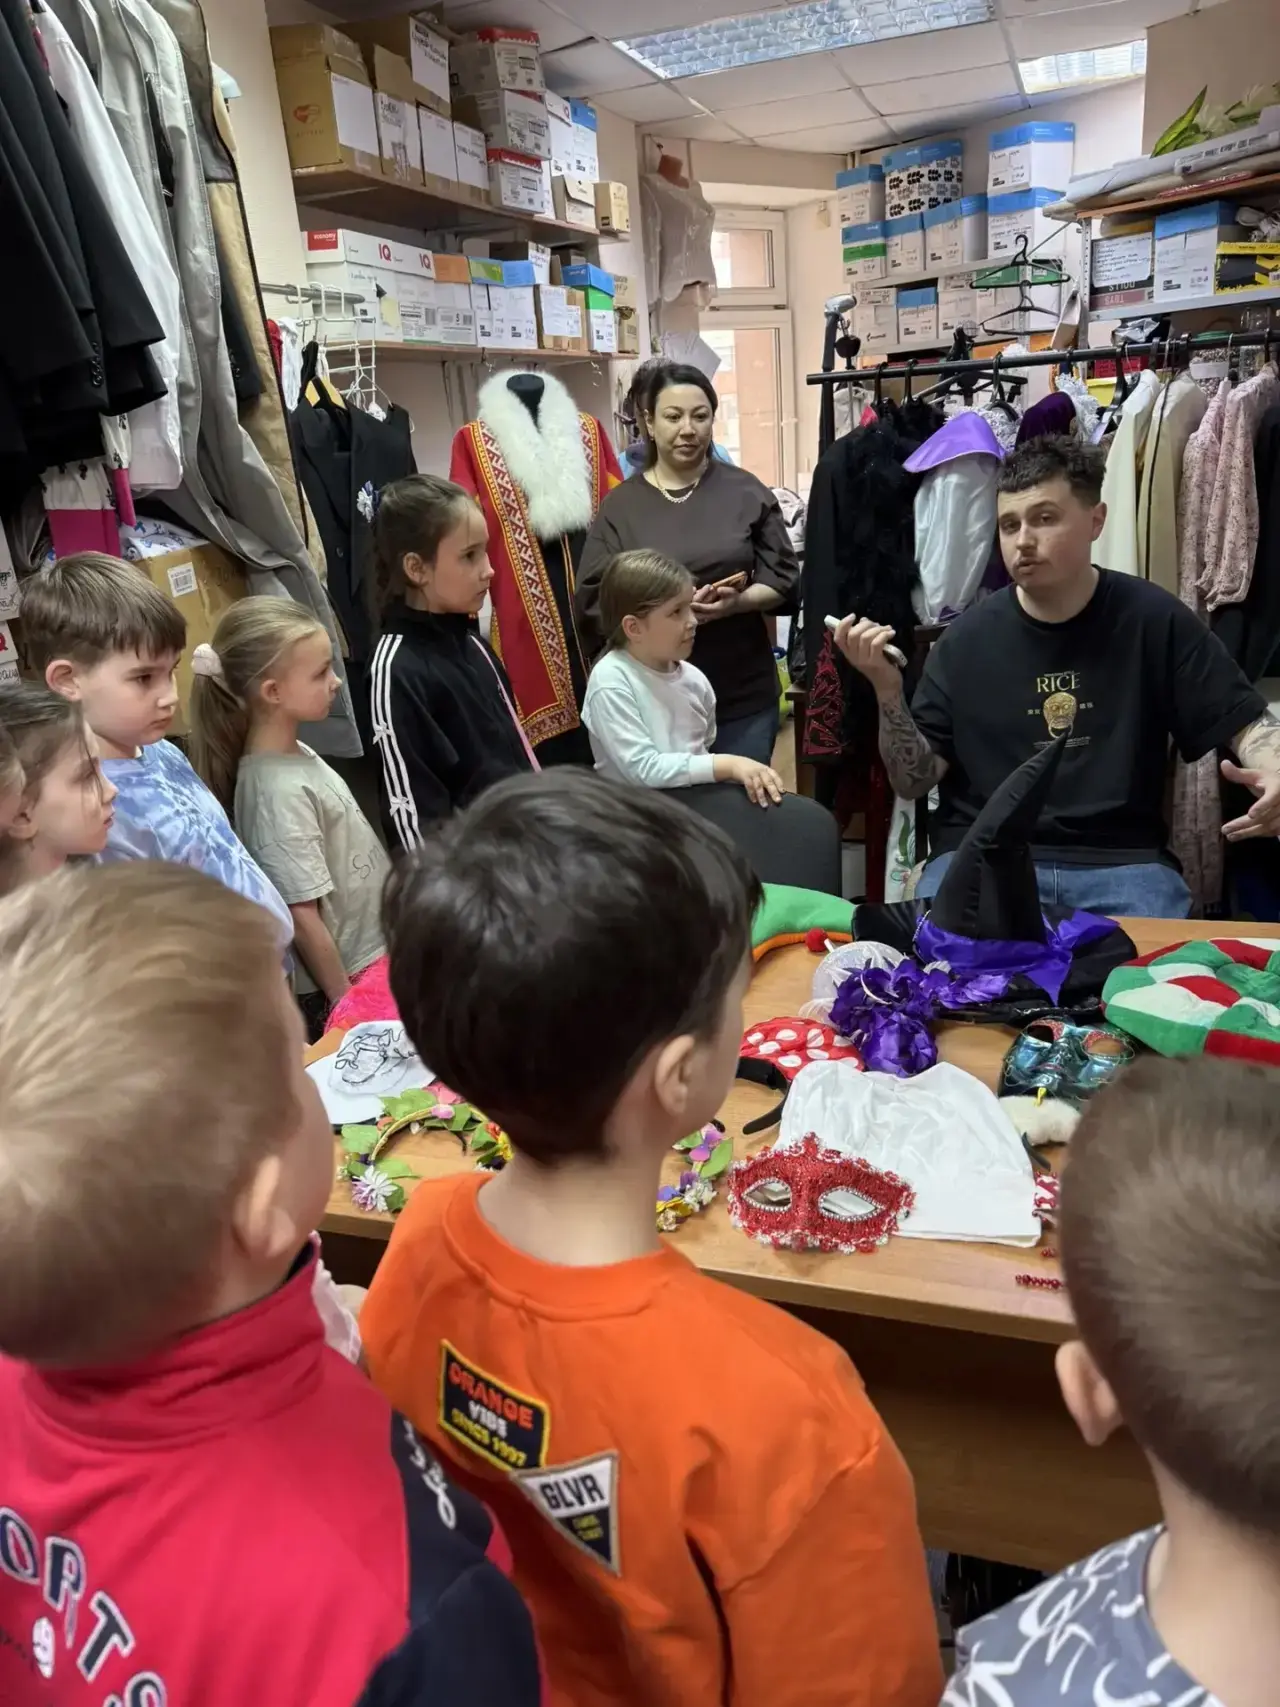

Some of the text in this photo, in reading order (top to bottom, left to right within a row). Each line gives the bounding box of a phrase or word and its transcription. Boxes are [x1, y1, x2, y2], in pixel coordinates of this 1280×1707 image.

[378, 243, 392, 262] IQ
[419, 252, 432, 271] IQ
[1036, 672, 1081, 693] RICE
[449, 1362, 534, 1429] ORANGE
[540, 1474, 604, 1510] GLVR
